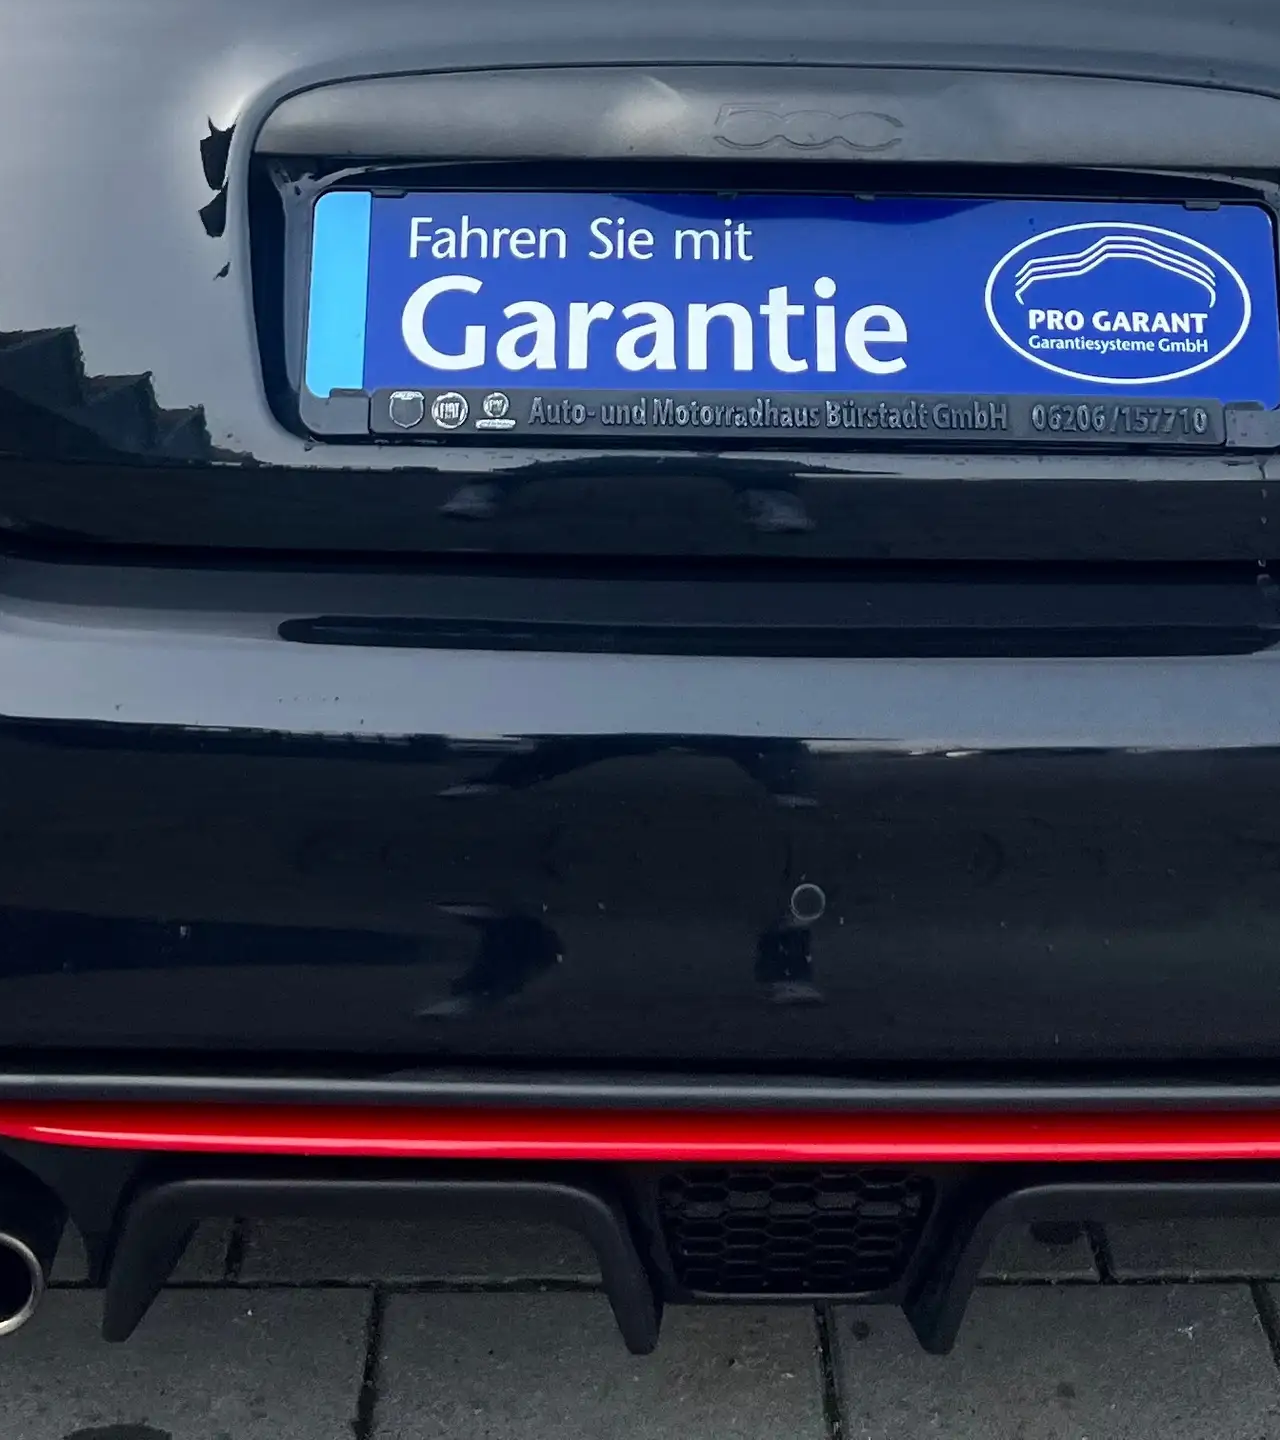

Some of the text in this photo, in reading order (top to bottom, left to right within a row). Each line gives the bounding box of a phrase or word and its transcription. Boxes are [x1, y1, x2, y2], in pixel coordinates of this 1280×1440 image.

[408, 215, 754, 261] Fahren Sie mit
[401, 273, 909, 375] Garantie
[1028, 309, 1209, 334] PRO GARANT
[1028, 334, 1209, 354] Garantiesysteme GmbH
[439, 402, 460, 420] FIAT
[528, 396, 596, 425] Auto-
[601, 397, 646, 426] und
[652, 397, 820, 428] Motorradhaus
[825, 399, 928, 430] Bürstadt
[932, 400, 1008, 431] GmbH
